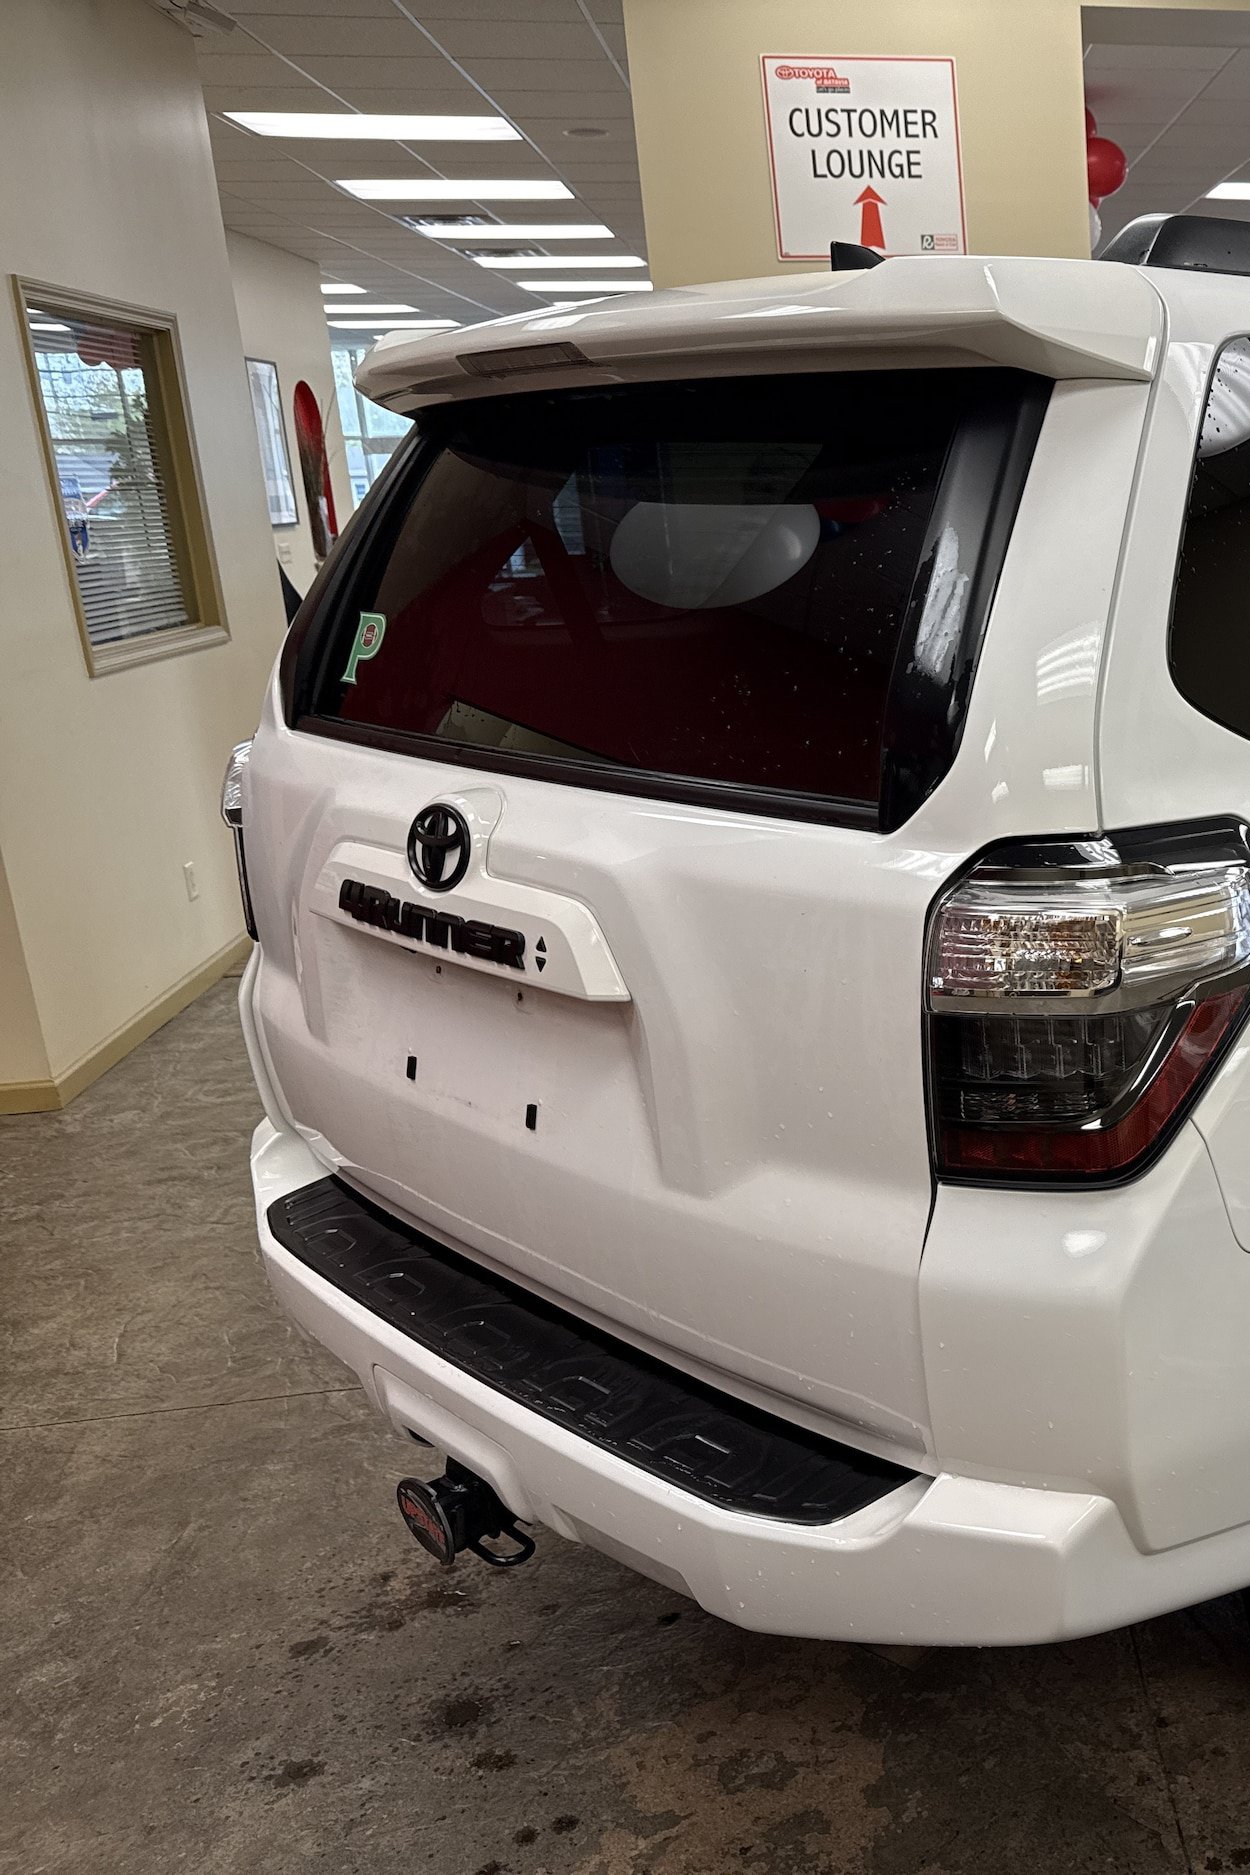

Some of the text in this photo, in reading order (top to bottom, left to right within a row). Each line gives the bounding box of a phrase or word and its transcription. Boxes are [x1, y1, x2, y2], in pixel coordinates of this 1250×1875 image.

[793, 68, 836, 79] TOYOTA
[788, 107, 939, 139] CUSTOMER
[810, 149, 923, 179] LOUNGE
